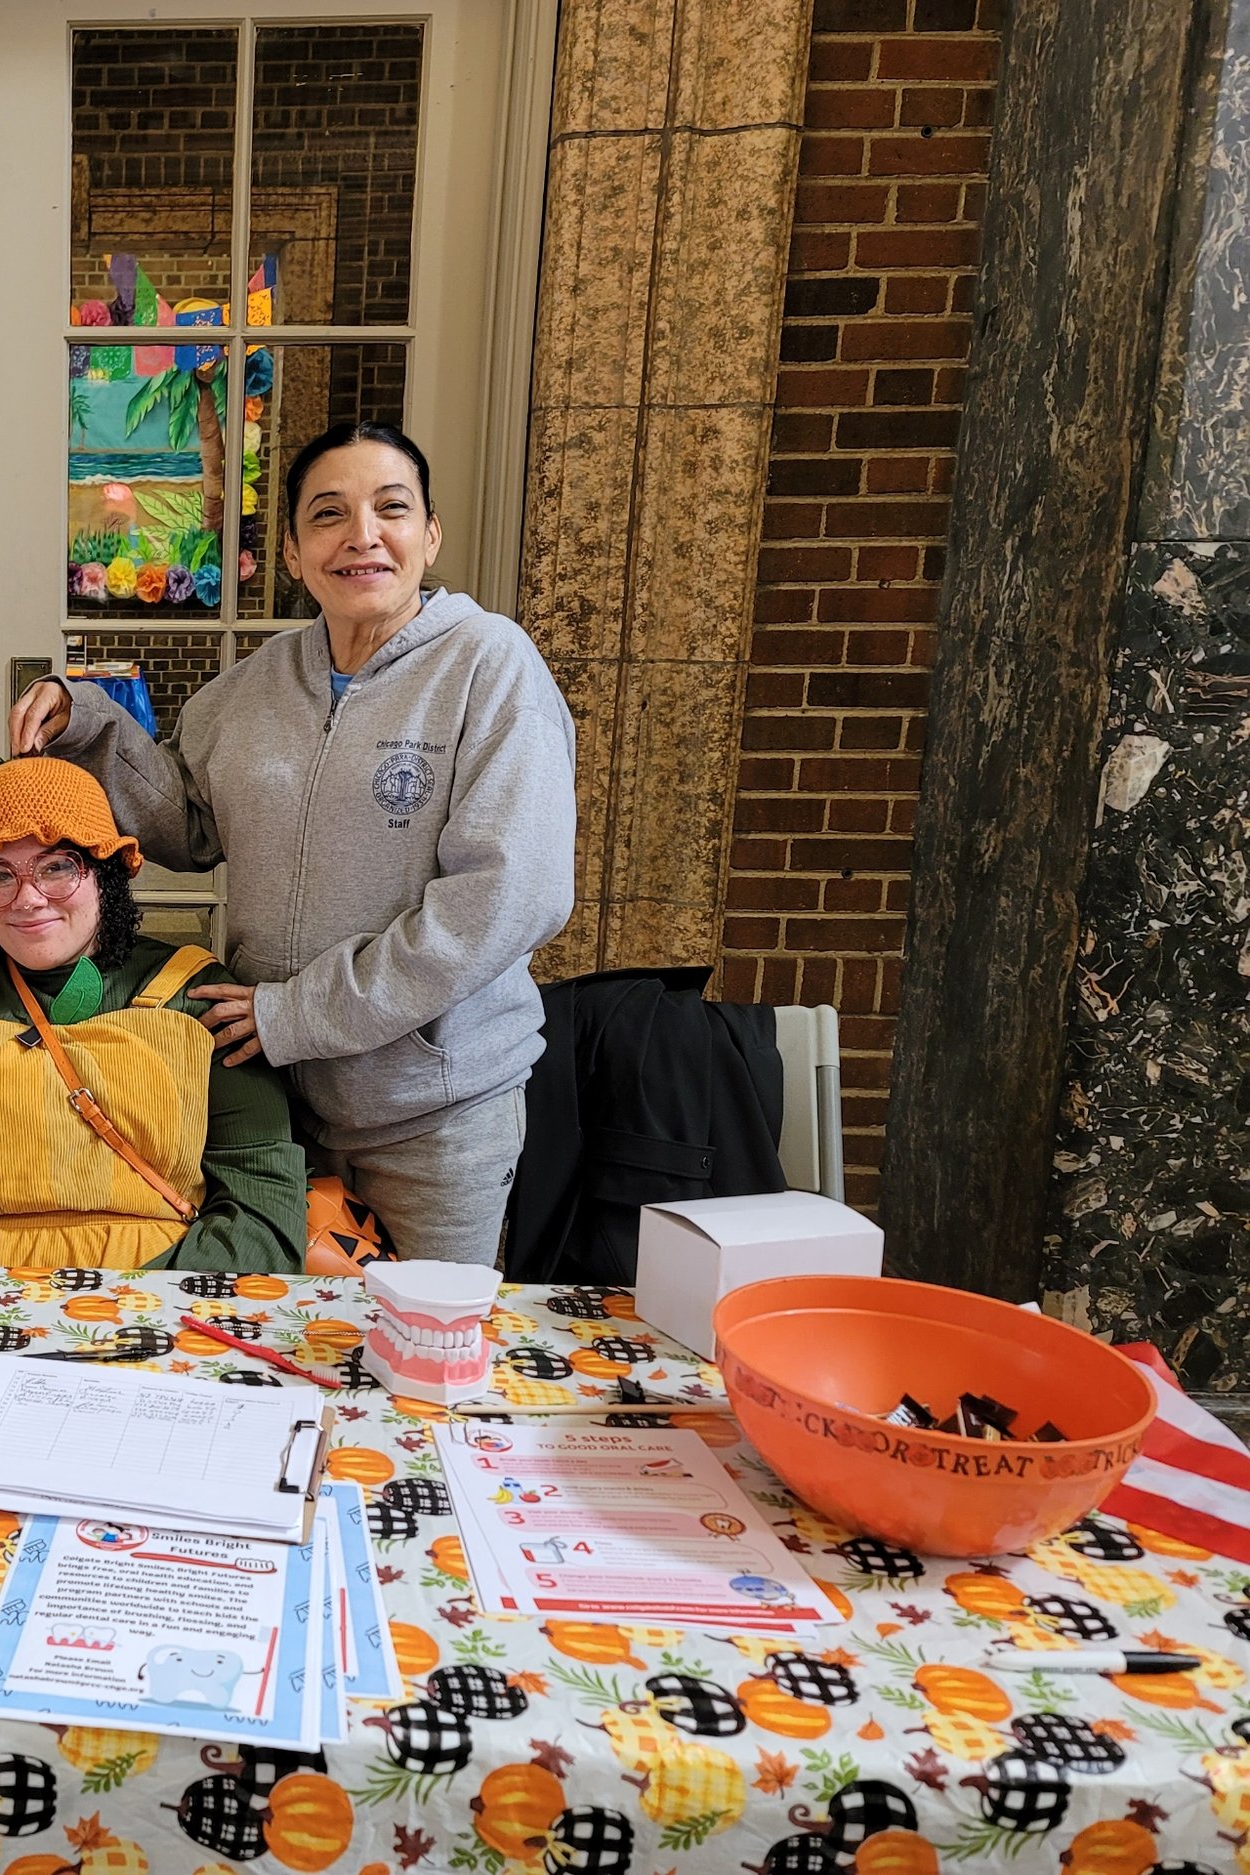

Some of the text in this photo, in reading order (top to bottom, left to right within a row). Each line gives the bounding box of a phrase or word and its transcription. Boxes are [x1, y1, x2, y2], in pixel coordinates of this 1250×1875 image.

[377, 740, 447, 753] Chicago Park District
[388, 818, 410, 829] Staff
[564, 1434, 633, 1445] 5 steps
[555, 1443, 597, 1451] GOOD
[871, 1430, 910, 1463] OR
[931, 1447, 1034, 1478] TREAT
[477, 1457, 499, 1469] 1
[540, 1484, 563, 1497] 2
[504, 1511, 525, 1524] 3
[151, 1532, 252, 1551] Smiles Bright
[573, 1541, 594, 1555] 4
[170, 1546, 228, 1559] Futures
[57, 1562, 89, 1571] brings
[92, 1565, 117, 1574] free,
[119, 1568, 139, 1576] oral
[141, 1570, 174, 1580] health
[177, 1575, 232, 1587] education,
[63, 1555, 252, 1581] Colgate Bright Smiles, Bright Futures
[58, 1570, 110, 1580] resources
[125, 1577, 168, 1587] children
[170, 1582, 190, 1590] and
[193, 1584, 236, 1595] families
[535, 1573, 558, 1588] 5
[56, 1579, 101, 1588] promote
[103, 1582, 143, 1593] lifelong
[145, 1587, 185, 1598] healthy
[188, 1592, 226, 1602] smiles.
[57, 1587, 102, 1596] program
[105, 1591, 151, 1601] partners
[153, 1596, 177, 1604] with
[179, 1600, 220, 1610] schools
[39, 1594, 107, 1605] communities
[110, 1601, 165, 1611] worldwide
[182, 1608, 213, 1617] teach
[215, 1612, 238, 1620] kids
[46, 1602, 108, 1613] importance
[124, 1610, 175, 1622] brushing,
[178, 1616, 224, 1628] flossing,
[34, 1610, 74, 1619] regular
[75, 1613, 110, 1622] dental
[112, 1617, 136, 1625] care
[138, 1619, 149, 1627] in
[161, 1623, 180, 1631] fun
[182, 1625, 203, 1633] and
[206, 1629, 256, 1641] engaging
[128, 1627, 156, 1637] way.
[54, 1654, 111, 1665] Please Email
[71, 1672, 126, 1683] information
